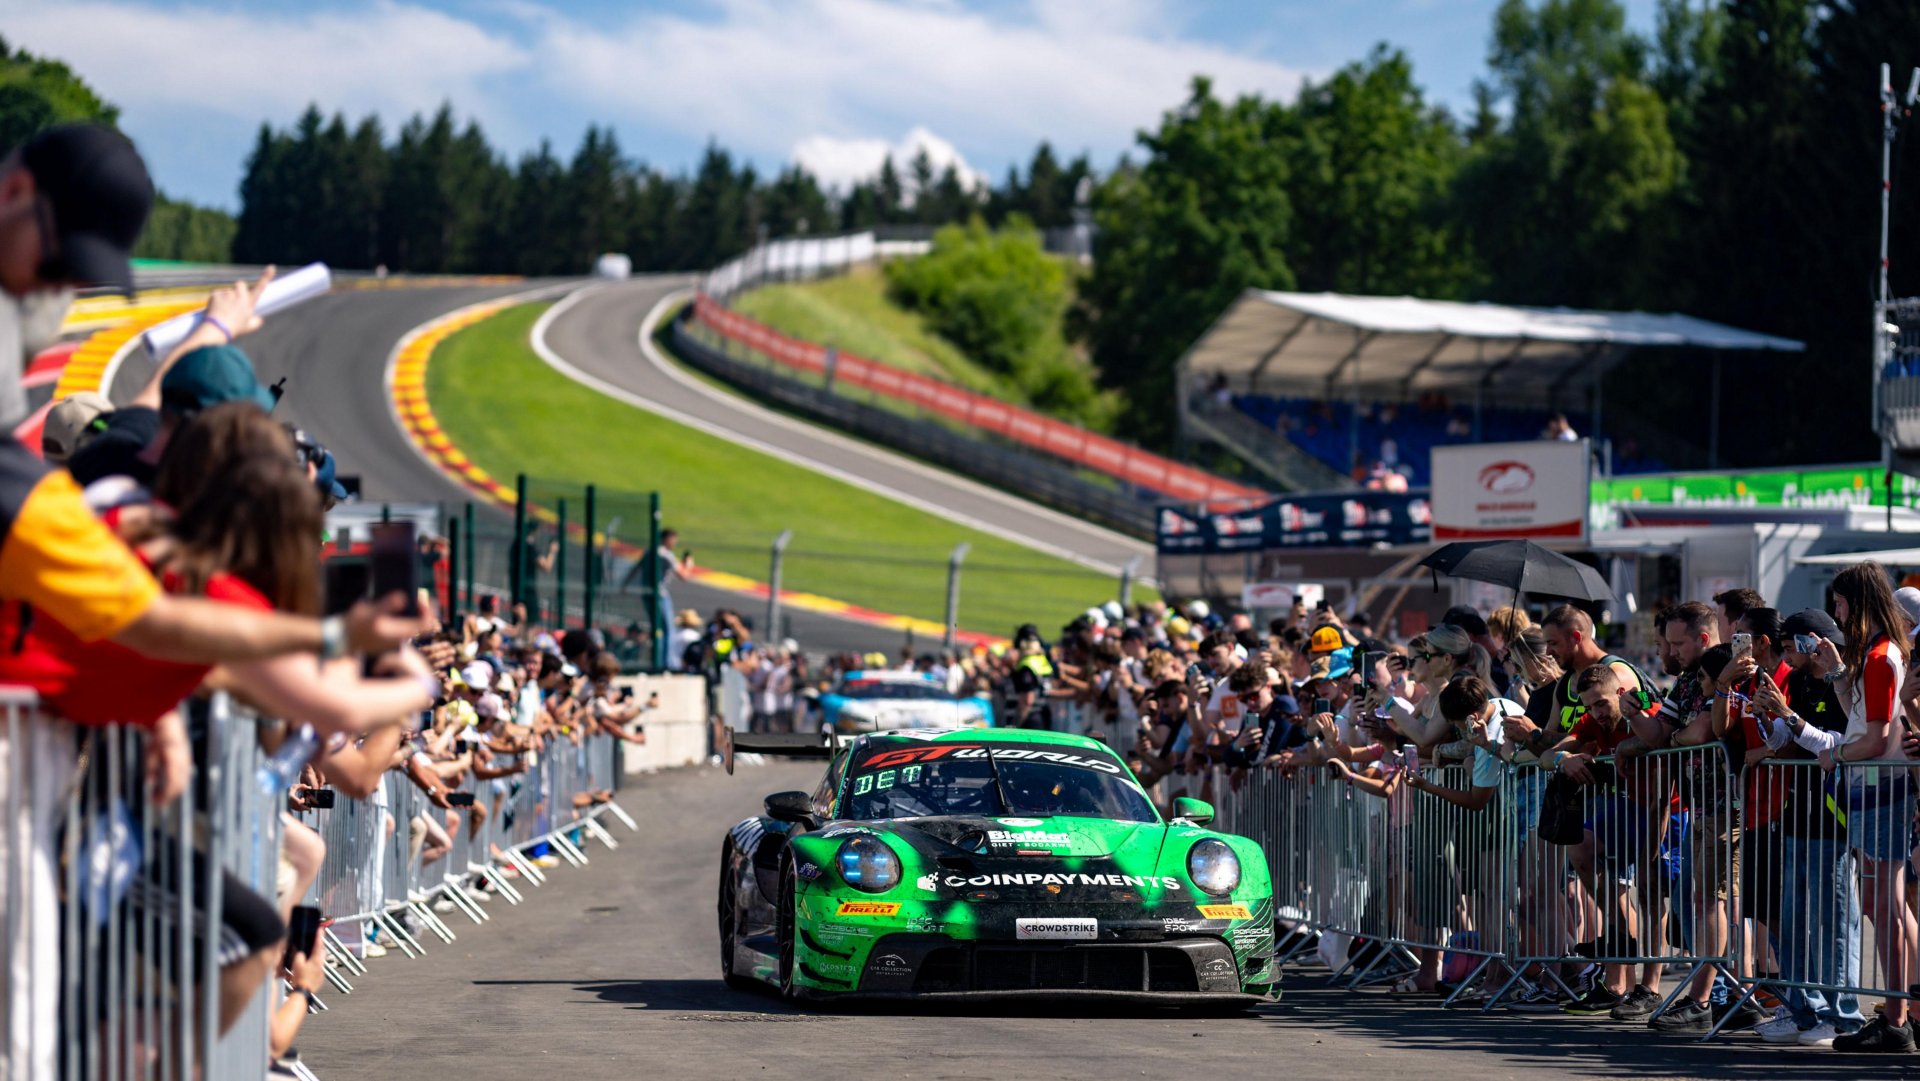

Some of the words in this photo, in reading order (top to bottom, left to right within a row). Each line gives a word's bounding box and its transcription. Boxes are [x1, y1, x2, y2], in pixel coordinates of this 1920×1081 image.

[987, 830, 1070, 843] BigMat
[944, 873, 1181, 891] COINPAYMENTS
[842, 904, 895, 914] PIRELLI
[1203, 907, 1247, 918] PIRELLI
[1025, 922, 1096, 932] CROWDSTRIKE
